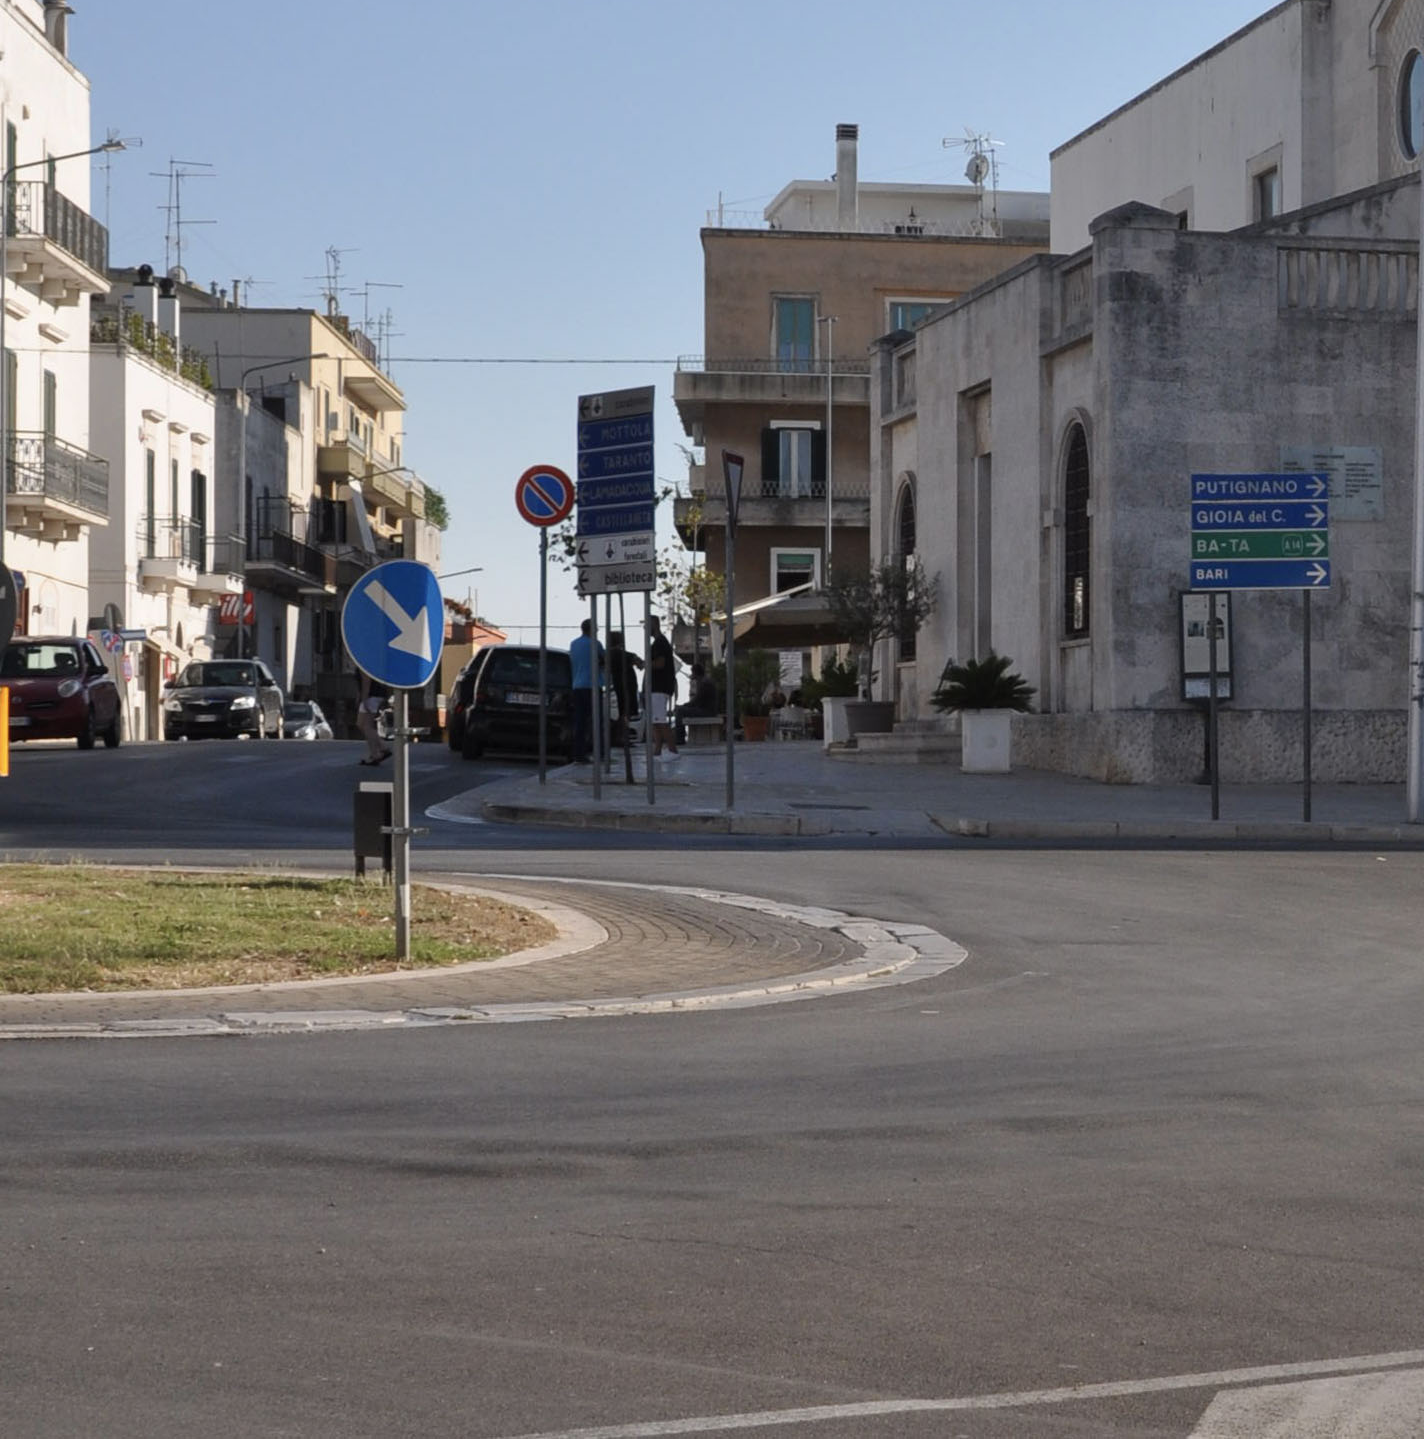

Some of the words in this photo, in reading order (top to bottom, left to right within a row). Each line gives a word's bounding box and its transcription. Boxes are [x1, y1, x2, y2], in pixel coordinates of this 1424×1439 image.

[603, 451, 651, 470] TARANTO
[1195, 479, 1298, 495] PUTIGNANO
[1196, 510, 1245, 524] GIOIA
[1248, 509, 1267, 523] del
[1271, 509, 1287, 523] C.
[1196, 538, 1250, 554] BA-TA
[604, 572, 654, 586] biblioteca
[1196, 568, 1229, 580] BARI
